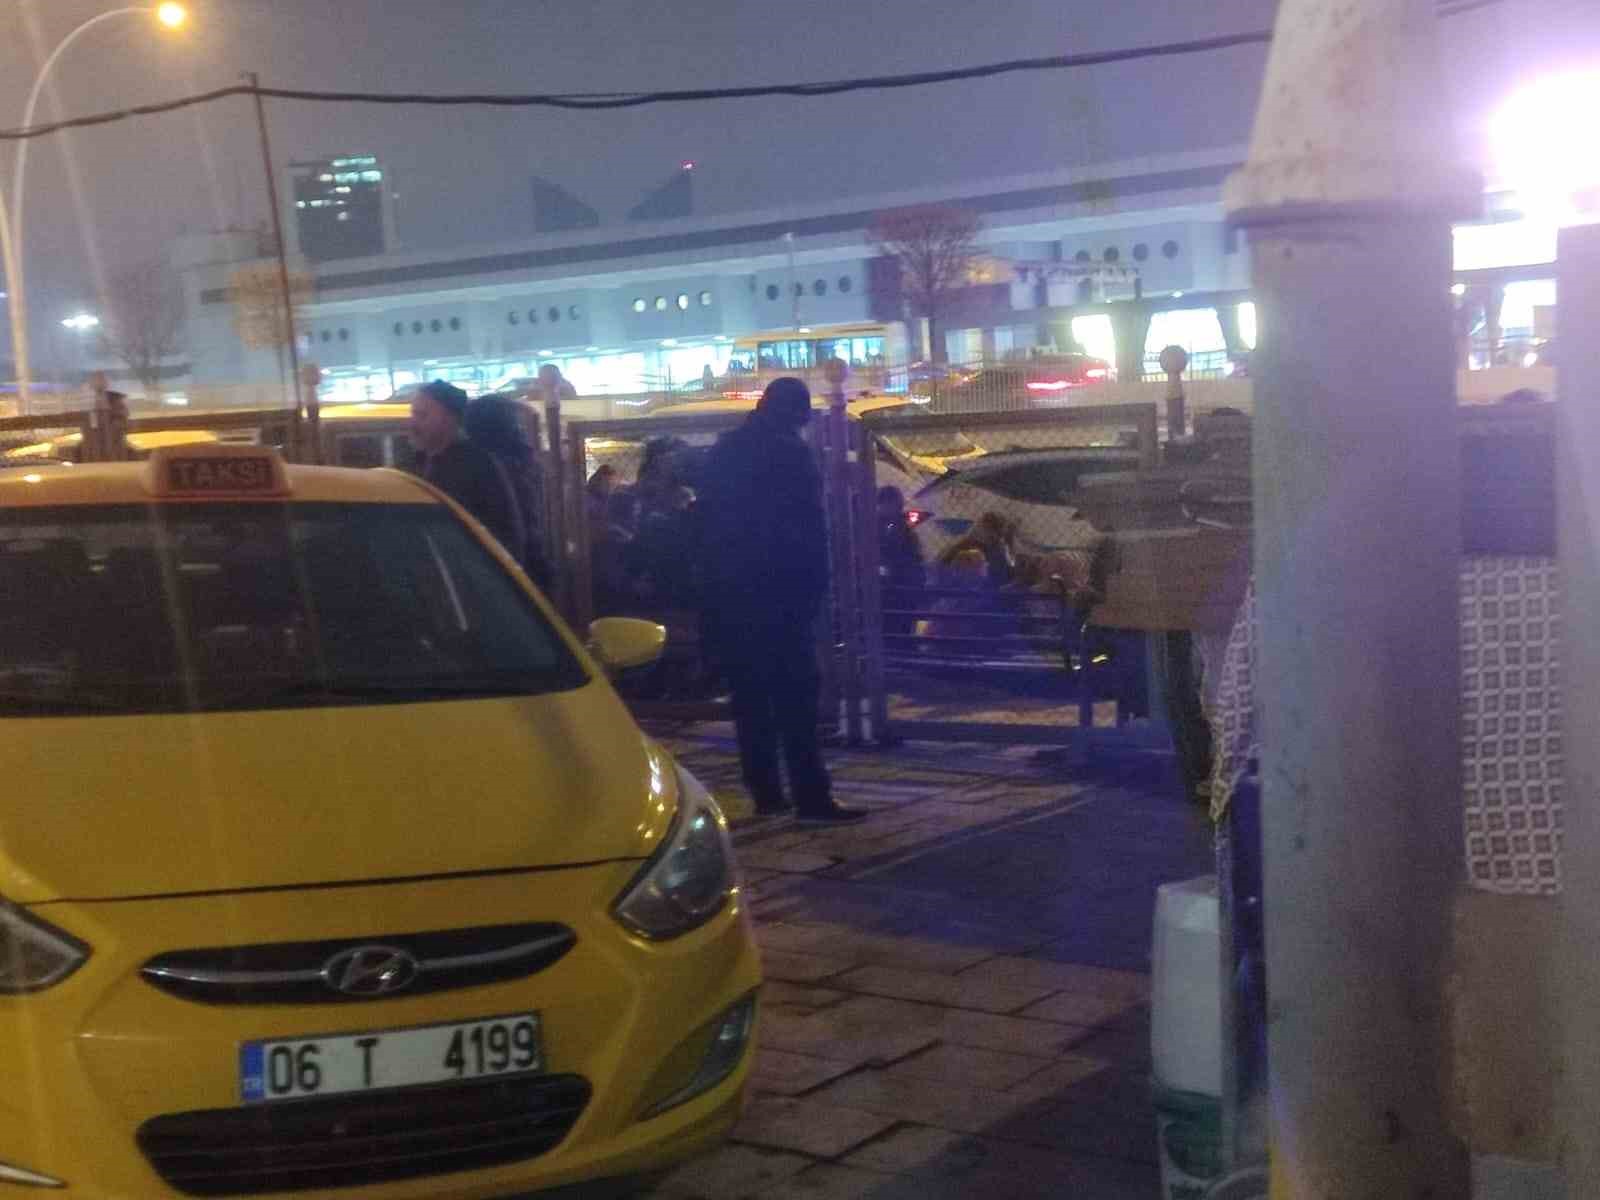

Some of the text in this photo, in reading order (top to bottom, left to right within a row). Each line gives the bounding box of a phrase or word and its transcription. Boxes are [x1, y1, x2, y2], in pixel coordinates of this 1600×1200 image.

[268, 1021, 537, 1094] 06 T 4199
